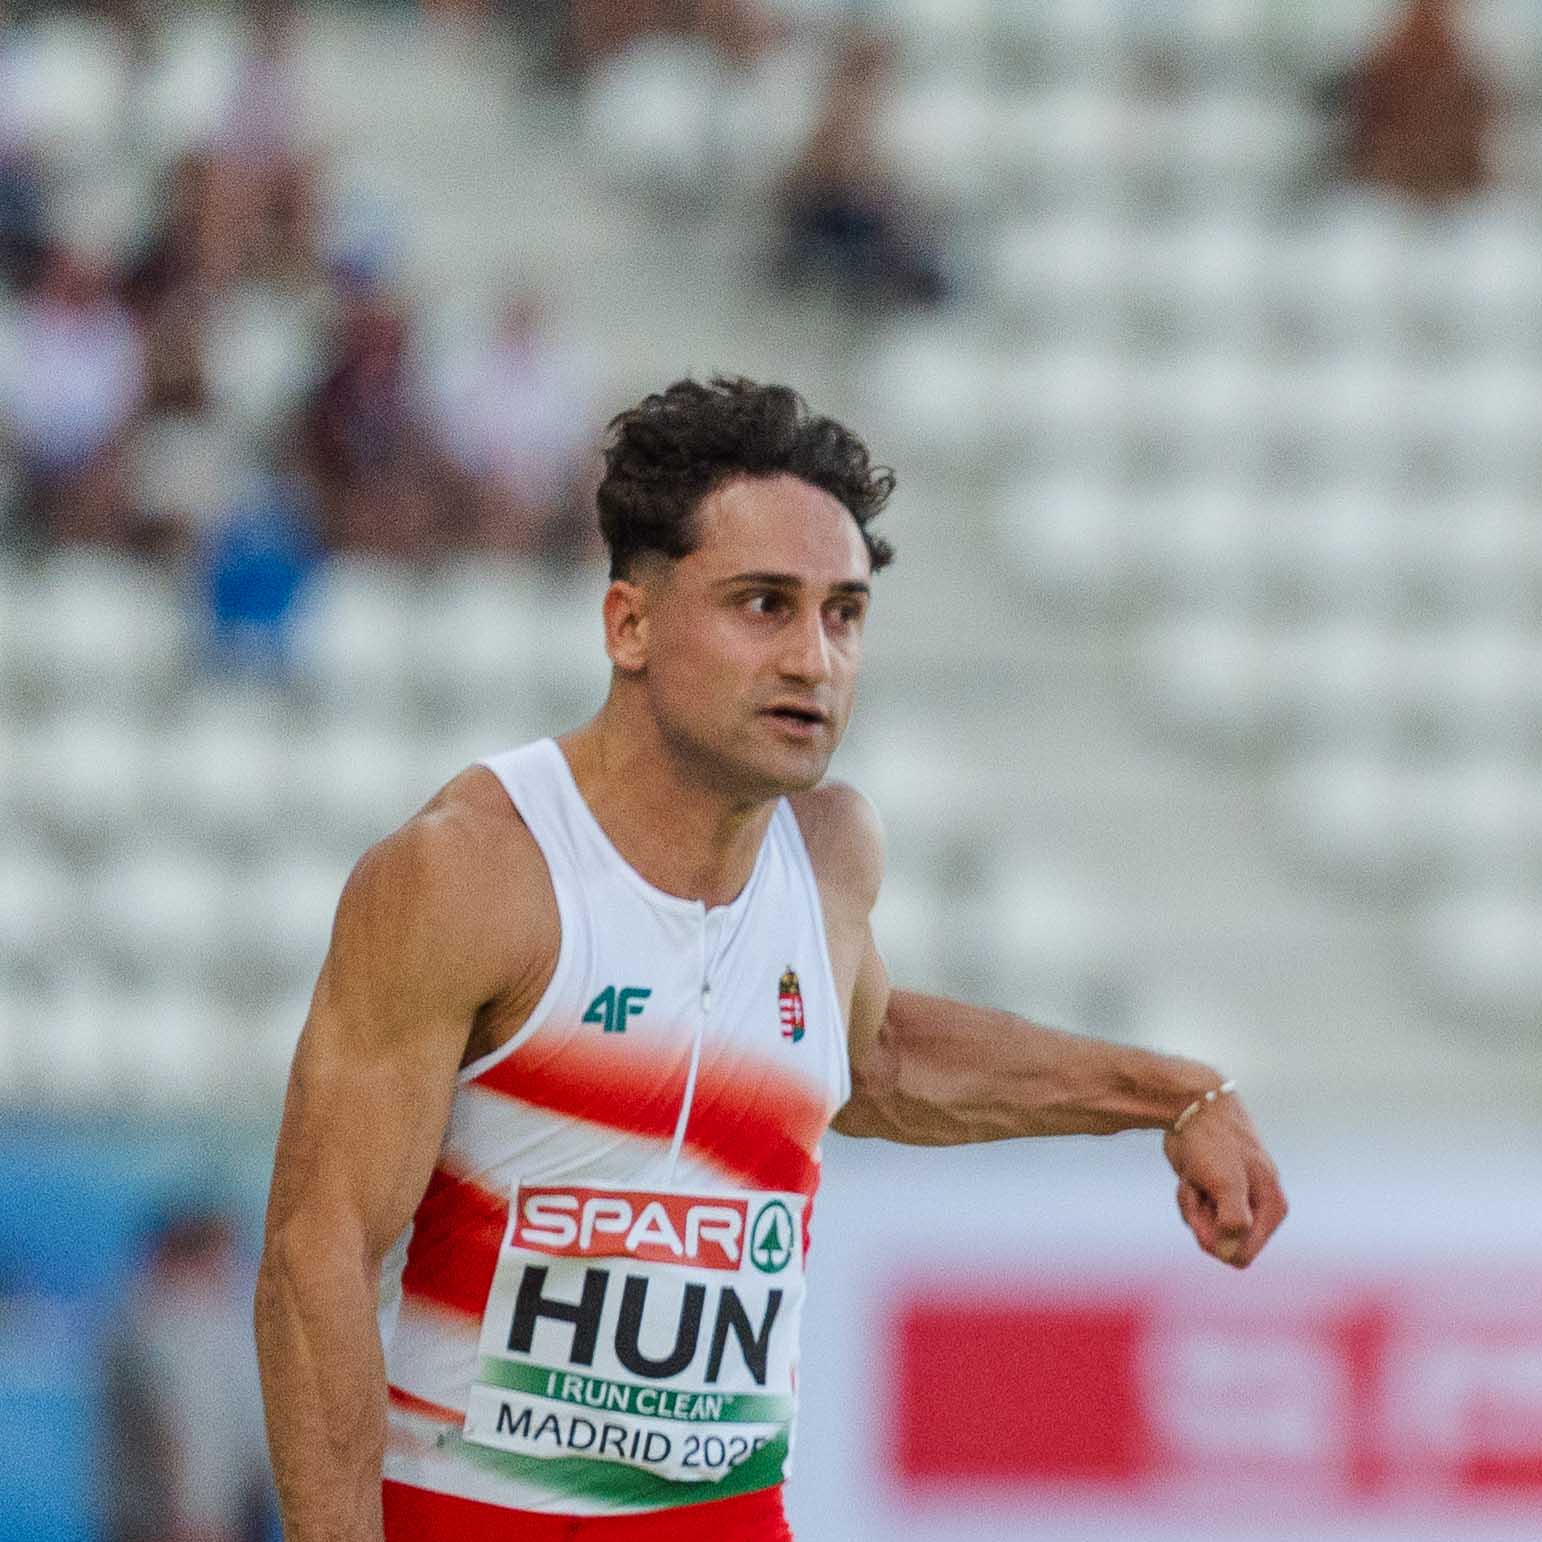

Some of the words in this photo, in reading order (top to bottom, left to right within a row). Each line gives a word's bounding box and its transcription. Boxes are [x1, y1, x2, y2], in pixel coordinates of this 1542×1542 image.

[582, 985, 652, 1033] 4F
[520, 1195, 742, 1261] SPAR
[505, 1264, 784, 1387] HUN
[547, 1373, 557, 1395] I
[561, 1376, 630, 1412] RUN
[636, 1389, 723, 1421] CLEAN
[496, 1403, 672, 1463] MADRID
